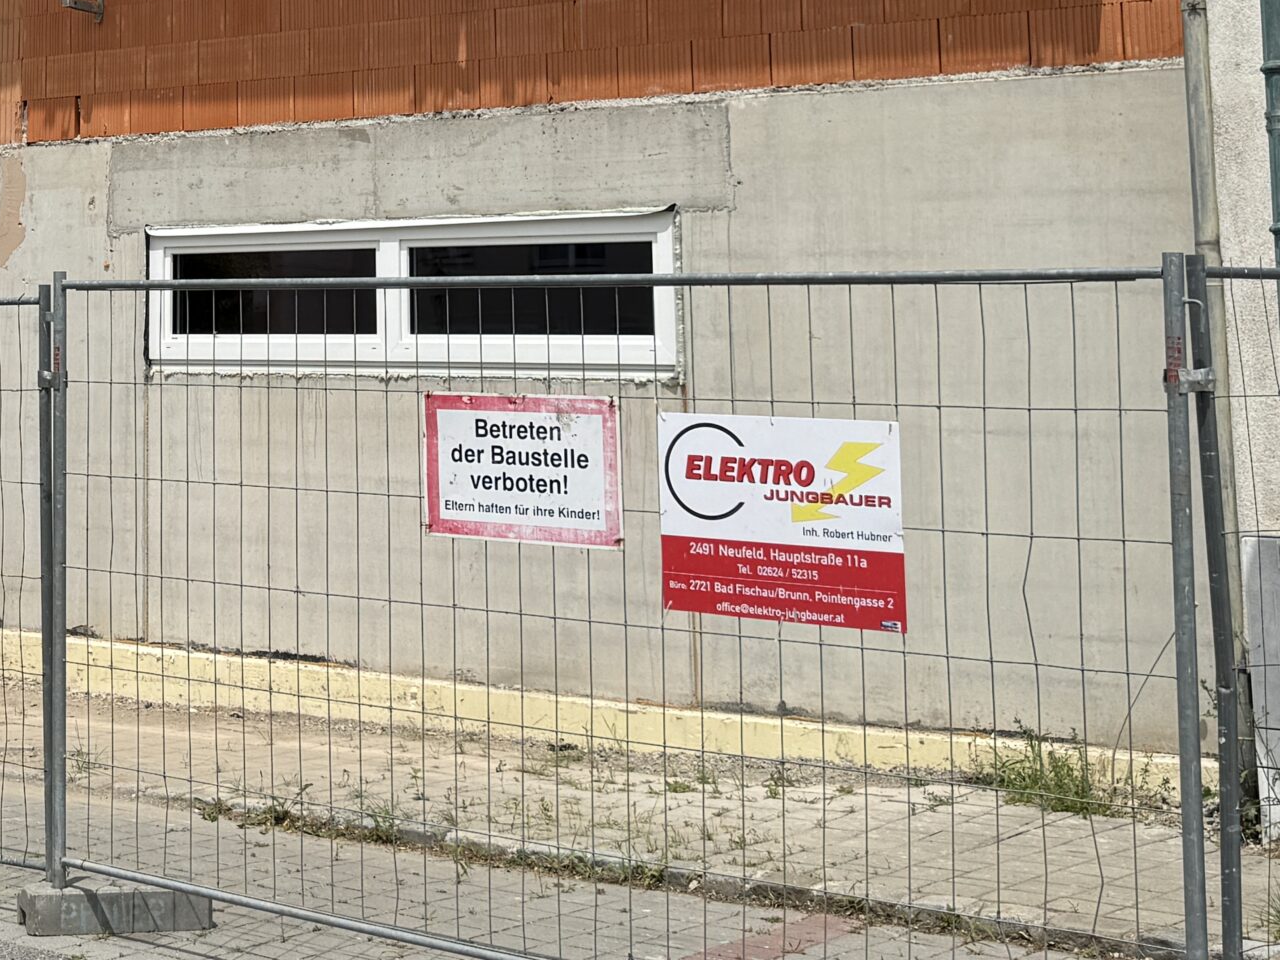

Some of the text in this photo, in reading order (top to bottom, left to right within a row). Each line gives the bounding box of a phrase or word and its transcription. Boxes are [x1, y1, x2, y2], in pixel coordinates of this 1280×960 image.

[475, 418, 562, 442] Betreten
[451, 444, 590, 470] der Baustelle
[685, 454, 816, 488] ELEKTRO
[470, 472, 569, 495] verboten!
[444, 499, 600, 520] Eltern haften für ihre Kinder!
[763, 490, 892, 508] JUNGBAUER
[802, 526, 820, 537] Inh.
[822, 527, 854, 540] Robert
[689, 541, 714, 555] 2491
[770, 548, 843, 567] Hauptstraße
[846, 553, 868, 568] 11a
[737, 563, 752, 575] Tel.
[757, 565, 784, 578] 02624
[791, 569, 818, 581] 52315
[689, 579, 711, 592] 2721
[714, 582, 734, 594] Bad
[815, 591, 885, 609] Pointengasse
[887, 597, 894, 609] 2
[716, 601, 845, 623] office@elektro-jungbauer.at
